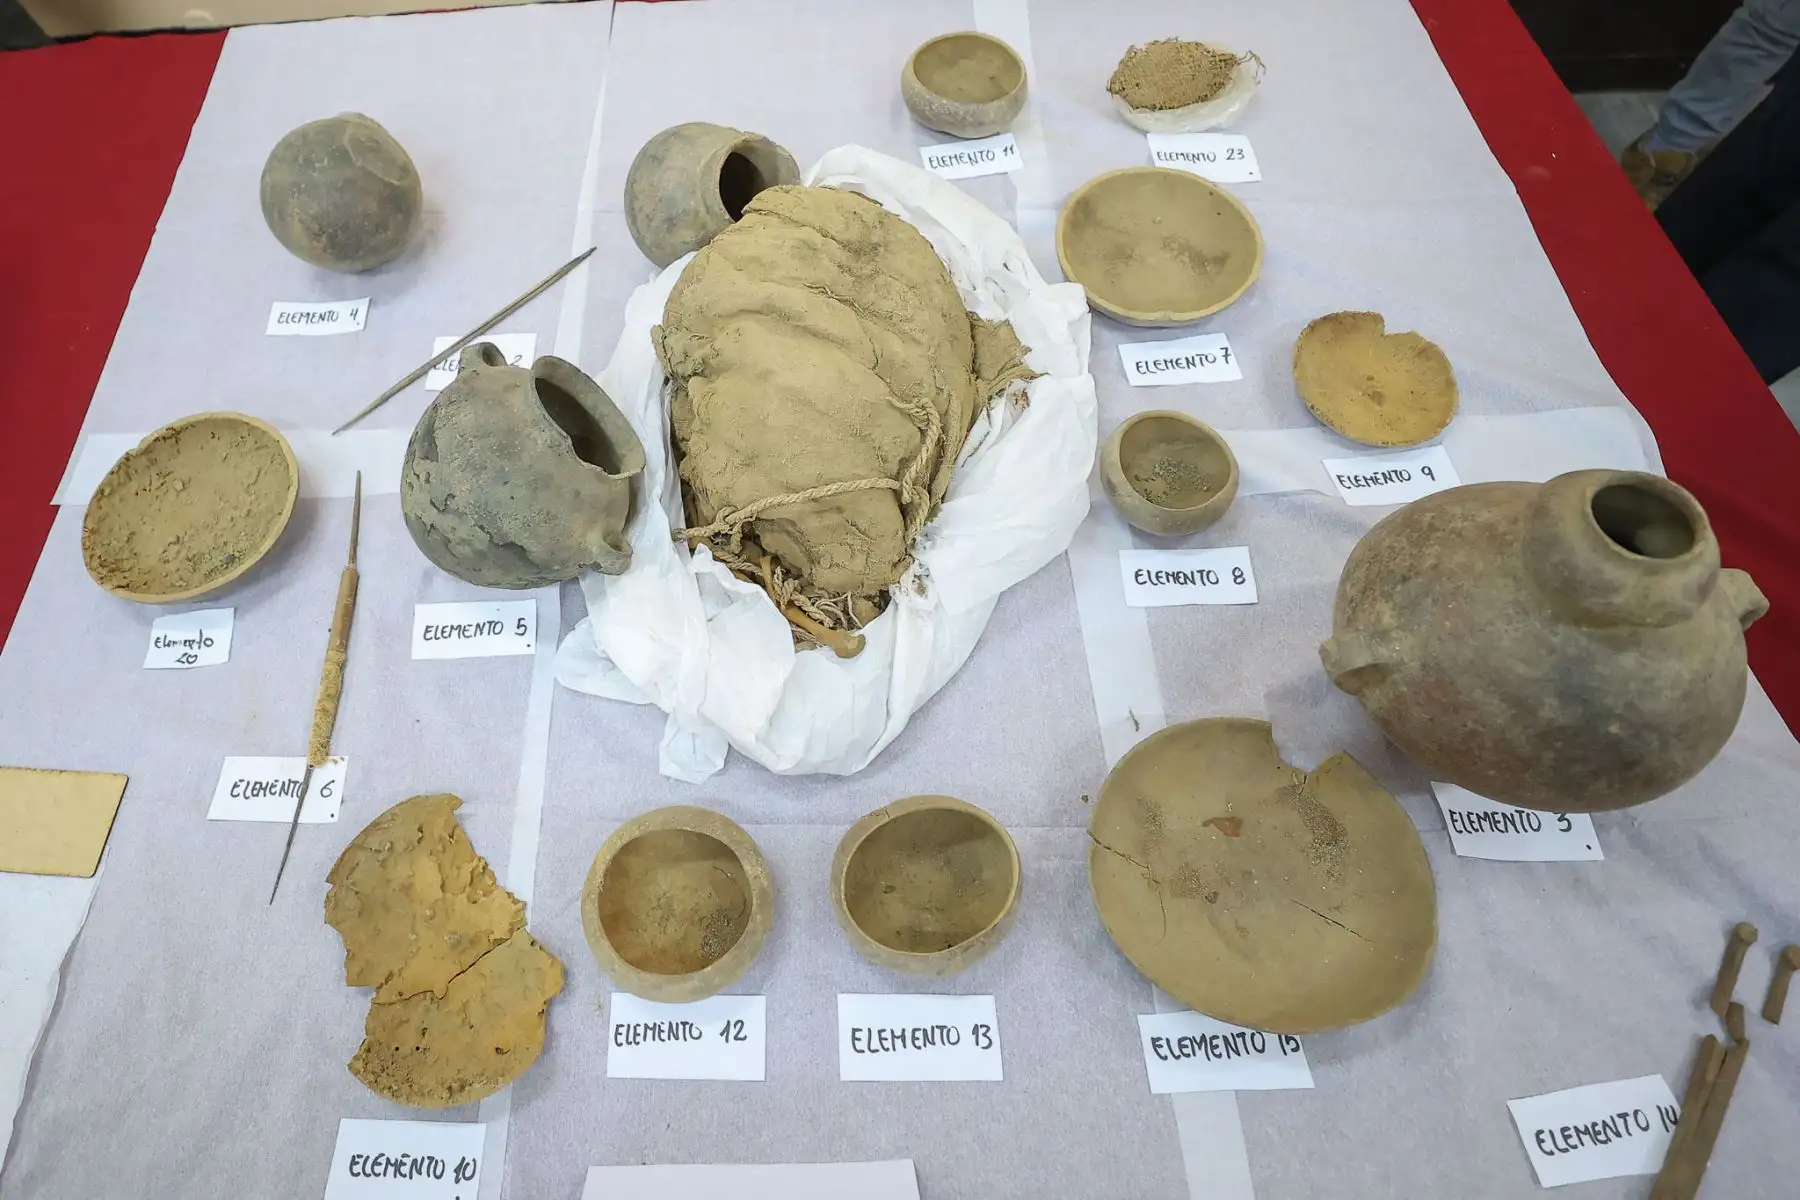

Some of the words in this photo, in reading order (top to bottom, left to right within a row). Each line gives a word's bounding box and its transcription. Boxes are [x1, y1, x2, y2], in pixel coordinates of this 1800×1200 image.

[929, 151, 995, 169] ELEMENTO
[1003, 144, 1015, 157] 11
[1157, 152, 1216, 163] ELEMENTO
[1226, 148, 1245, 161] 23
[278, 312, 339, 324] ELEMENTO
[349, 308, 360, 321] 4
[1136, 353, 1217, 374] ELEMENTO
[1220, 347, 1231, 364] 7
[1337, 469, 1411, 489] ELEMENTO
[1422, 466, 1435, 481] 9
[1135, 569, 1218, 585] ELEMENTO
[1232, 569, 1245, 585] 8
[423, 622, 503, 640] ELEMENTO
[514, 618, 527, 635] 5
[175, 653, 197, 664] 20
[320, 780, 334, 797] 6
[1450, 809, 1541, 835] ELEMENTO
[1557, 812, 1571, 831] 3
[614, 1022, 702, 1047] ELEMENTO
[719, 1020, 747, 1043] 12
[851, 1025, 960, 1054] ELEMENTO
[972, 1025, 992, 1049] 13
[1151, 1032, 1266, 1061] ELEMENTO
[1535, 1112, 1649, 1156] ELEMENTO
[349, 1153, 445, 1179] ELEMENTO
[454, 1158, 476, 1183] 10
